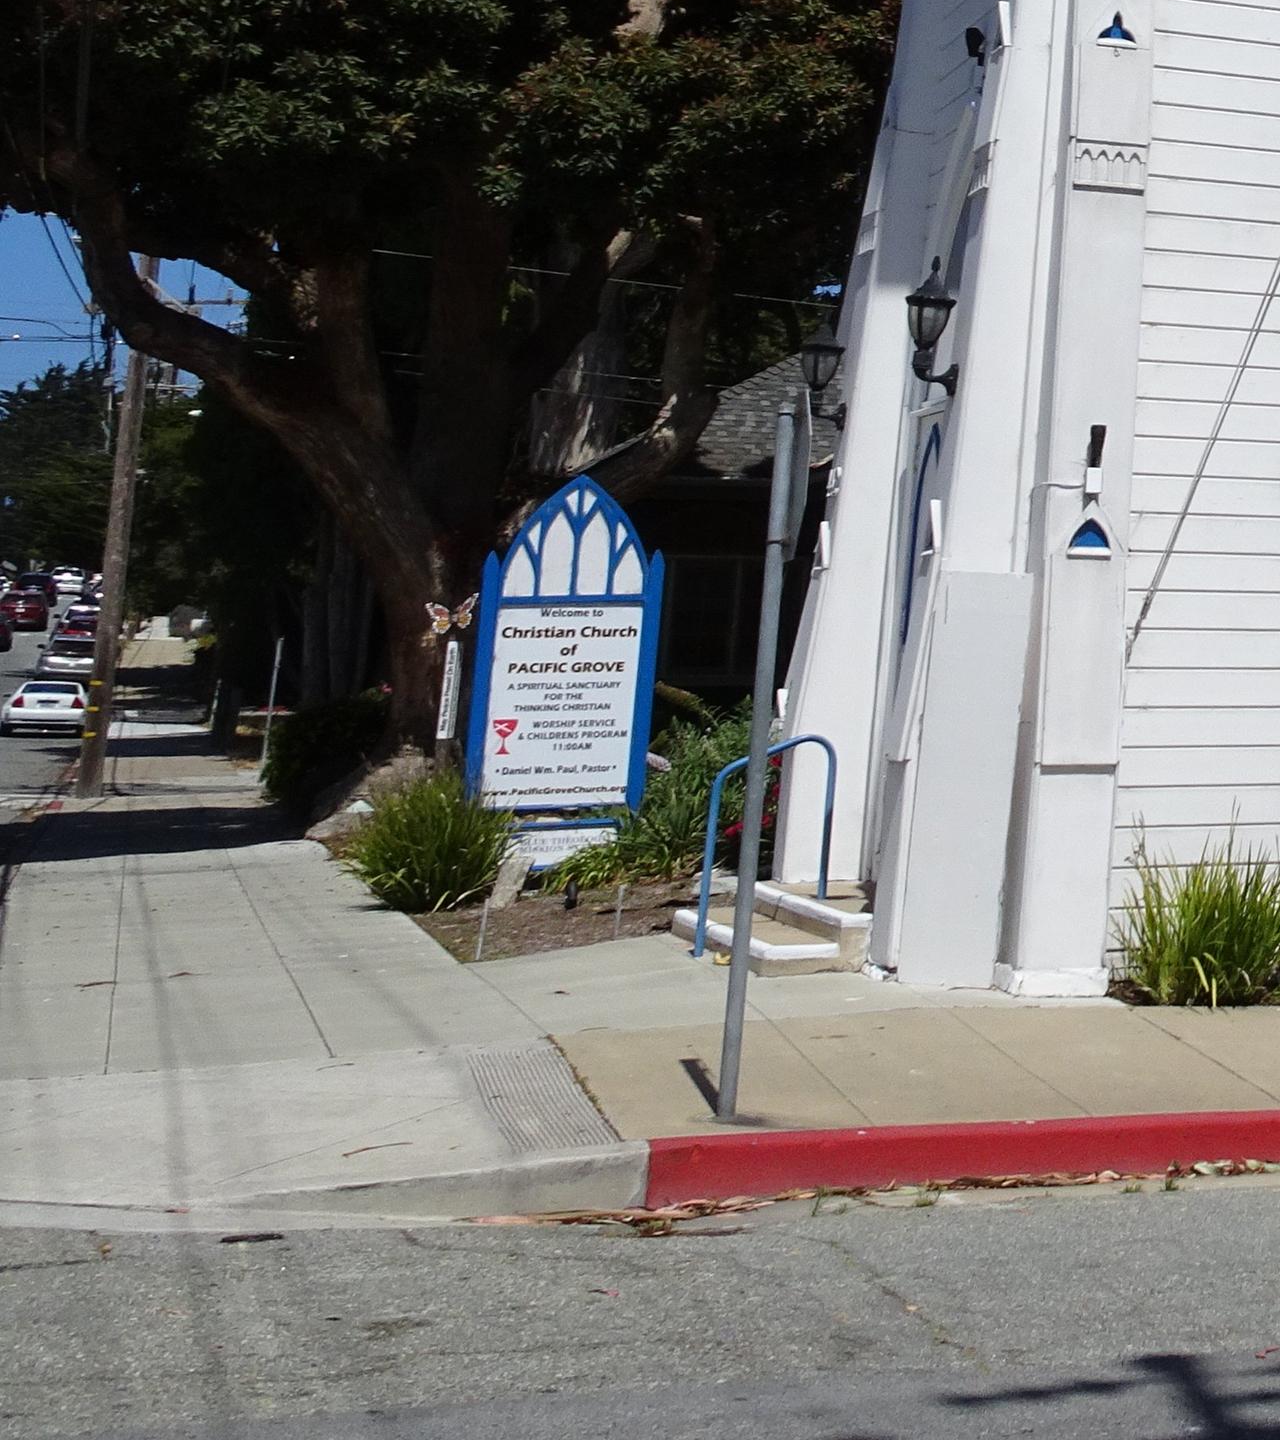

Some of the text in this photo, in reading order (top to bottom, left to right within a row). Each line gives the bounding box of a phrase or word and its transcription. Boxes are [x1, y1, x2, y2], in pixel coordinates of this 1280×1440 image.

[541, 608, 604, 617] Welcome to
[502, 626, 637, 639] Christian Church
[560, 644, 578, 656] of
[508, 661, 625, 674] PACIFIC GROVE
[517, 682, 563, 690] SPIRITUAL
[566, 681, 621, 690] SANCTUARY
[544, 693, 562, 701] FOR
[514, 703, 611, 712] THINKING CHRISTIAN
[533, 719, 616, 728] WORSHIP SERVICE
[527, 732, 579, 740] CHILDRENS
[581, 730, 628, 739] PROGRAM
[553, 743, 592, 751] 11:00AM
[502, 764, 610, 775] Daniel Wm. Paul, Pastor
